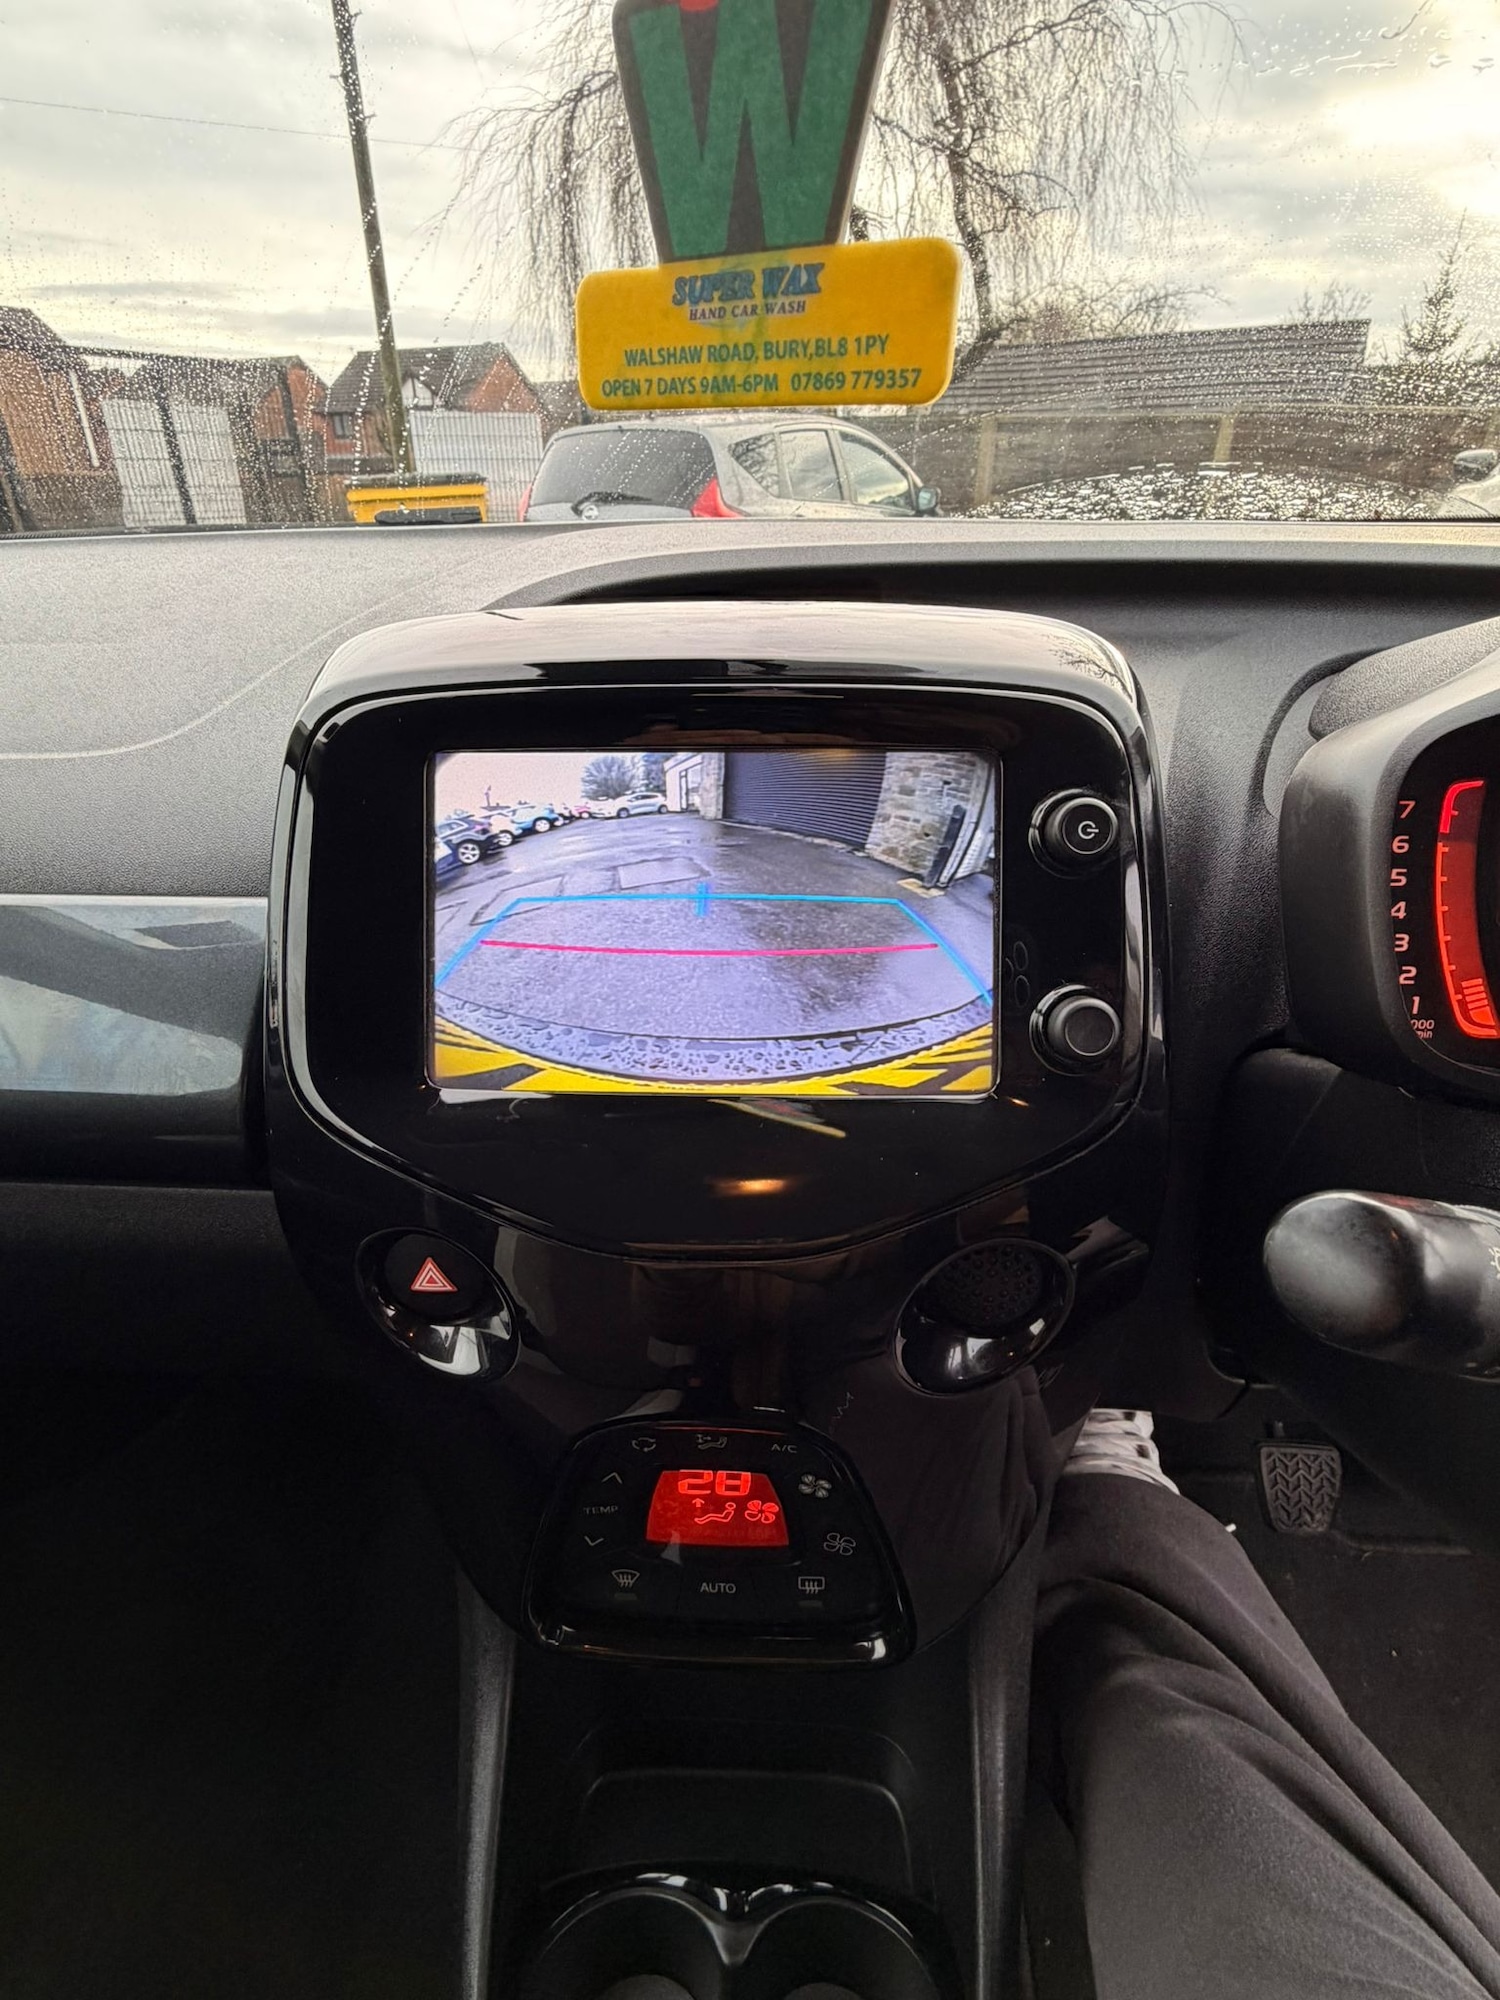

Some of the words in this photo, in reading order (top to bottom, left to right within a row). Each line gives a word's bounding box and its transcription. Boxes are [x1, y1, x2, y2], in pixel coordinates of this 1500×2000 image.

[672, 269, 755, 306] SUPER
[762, 263, 825, 299] WAX
[689, 306, 726, 321] HAND
[731, 303, 758, 318] CAR
[764, 300, 806, 315] WASH
[624, 345, 703, 367] WALSHAW
[707, 342, 760, 364] ROAD,
[854, 333, 889, 356] 1PY
[601, 378, 641, 398] OPEN
[644, 378, 653, 396] 7
[657, 376, 696, 396] DAYS
[700, 373, 779, 395] 9AM-6PM
[790, 370, 847, 392] 07869
[851, 367, 923, 390] 779357
[1399, 801, 1416, 819] 7
[1391, 835, 1410, 853] 6
[1390, 868, 1407, 887] 5
[1390, 901, 1407, 919] 4
[1394, 934, 1410, 952] 3
[1398, 966, 1417, 985] 2
[1412, 996, 1420, 1015] 1
[771, 1443, 798, 1454] A/C
[678, 1469, 751, 1496] 28
[583, 1504, 619, 1515] TEMP
[700, 1582, 737, 1594] AUTO
